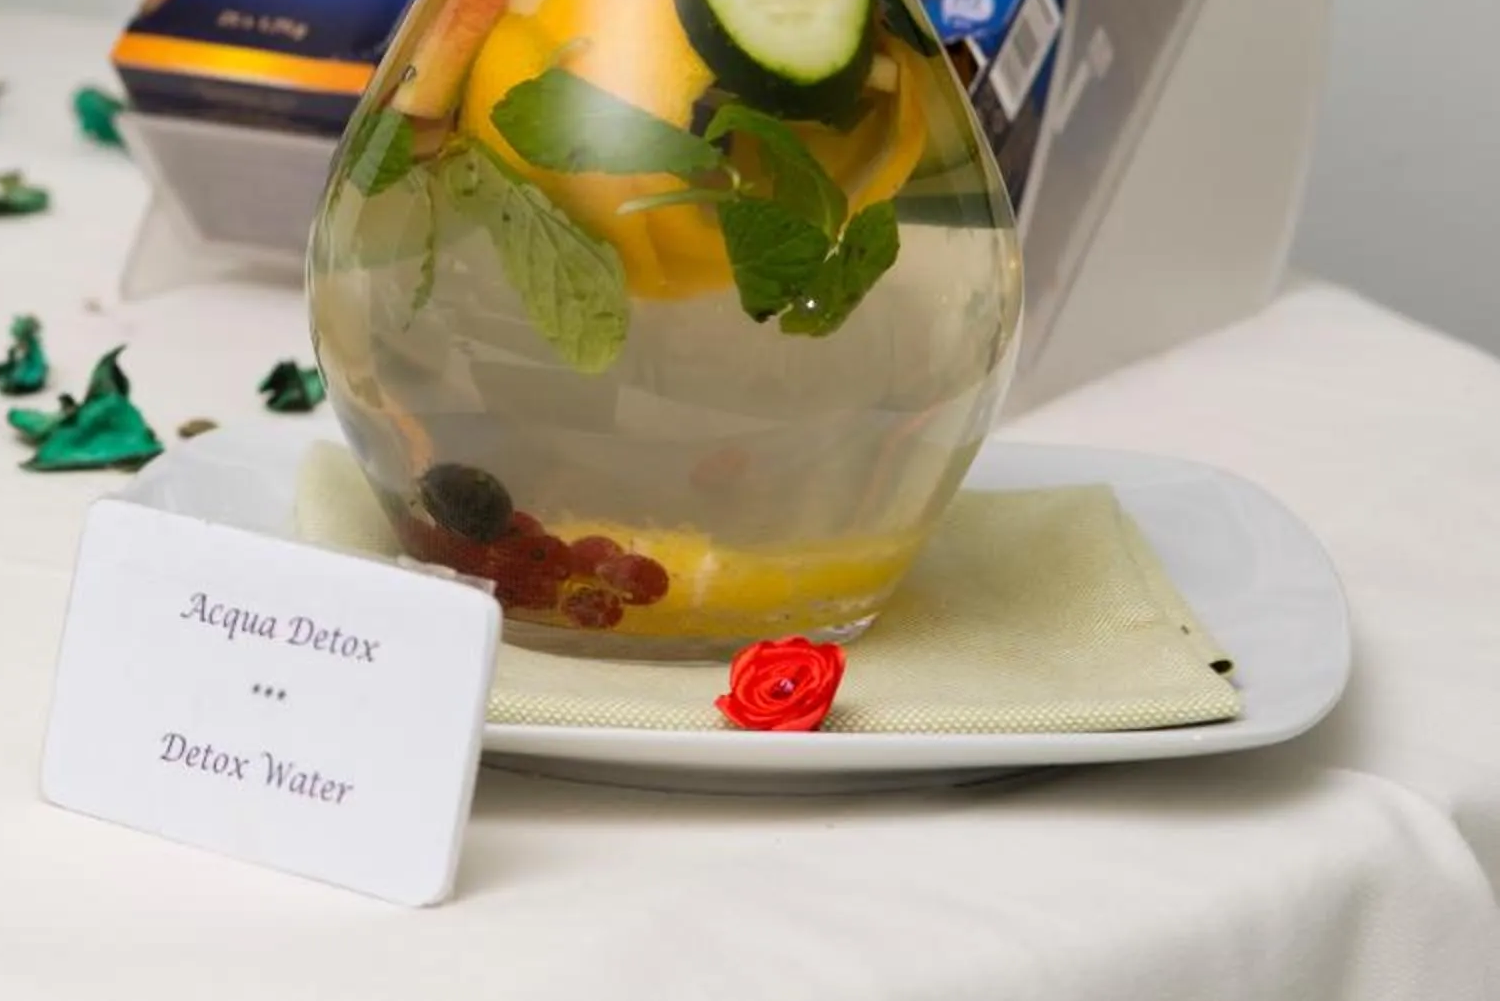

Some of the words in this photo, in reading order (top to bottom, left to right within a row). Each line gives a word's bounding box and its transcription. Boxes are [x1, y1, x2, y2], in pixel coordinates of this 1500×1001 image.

[180, 592, 277, 640] Acqua
[286, 615, 380, 663] Detox
[160, 732, 250, 781] Detox
[260, 751, 354, 804] Water
